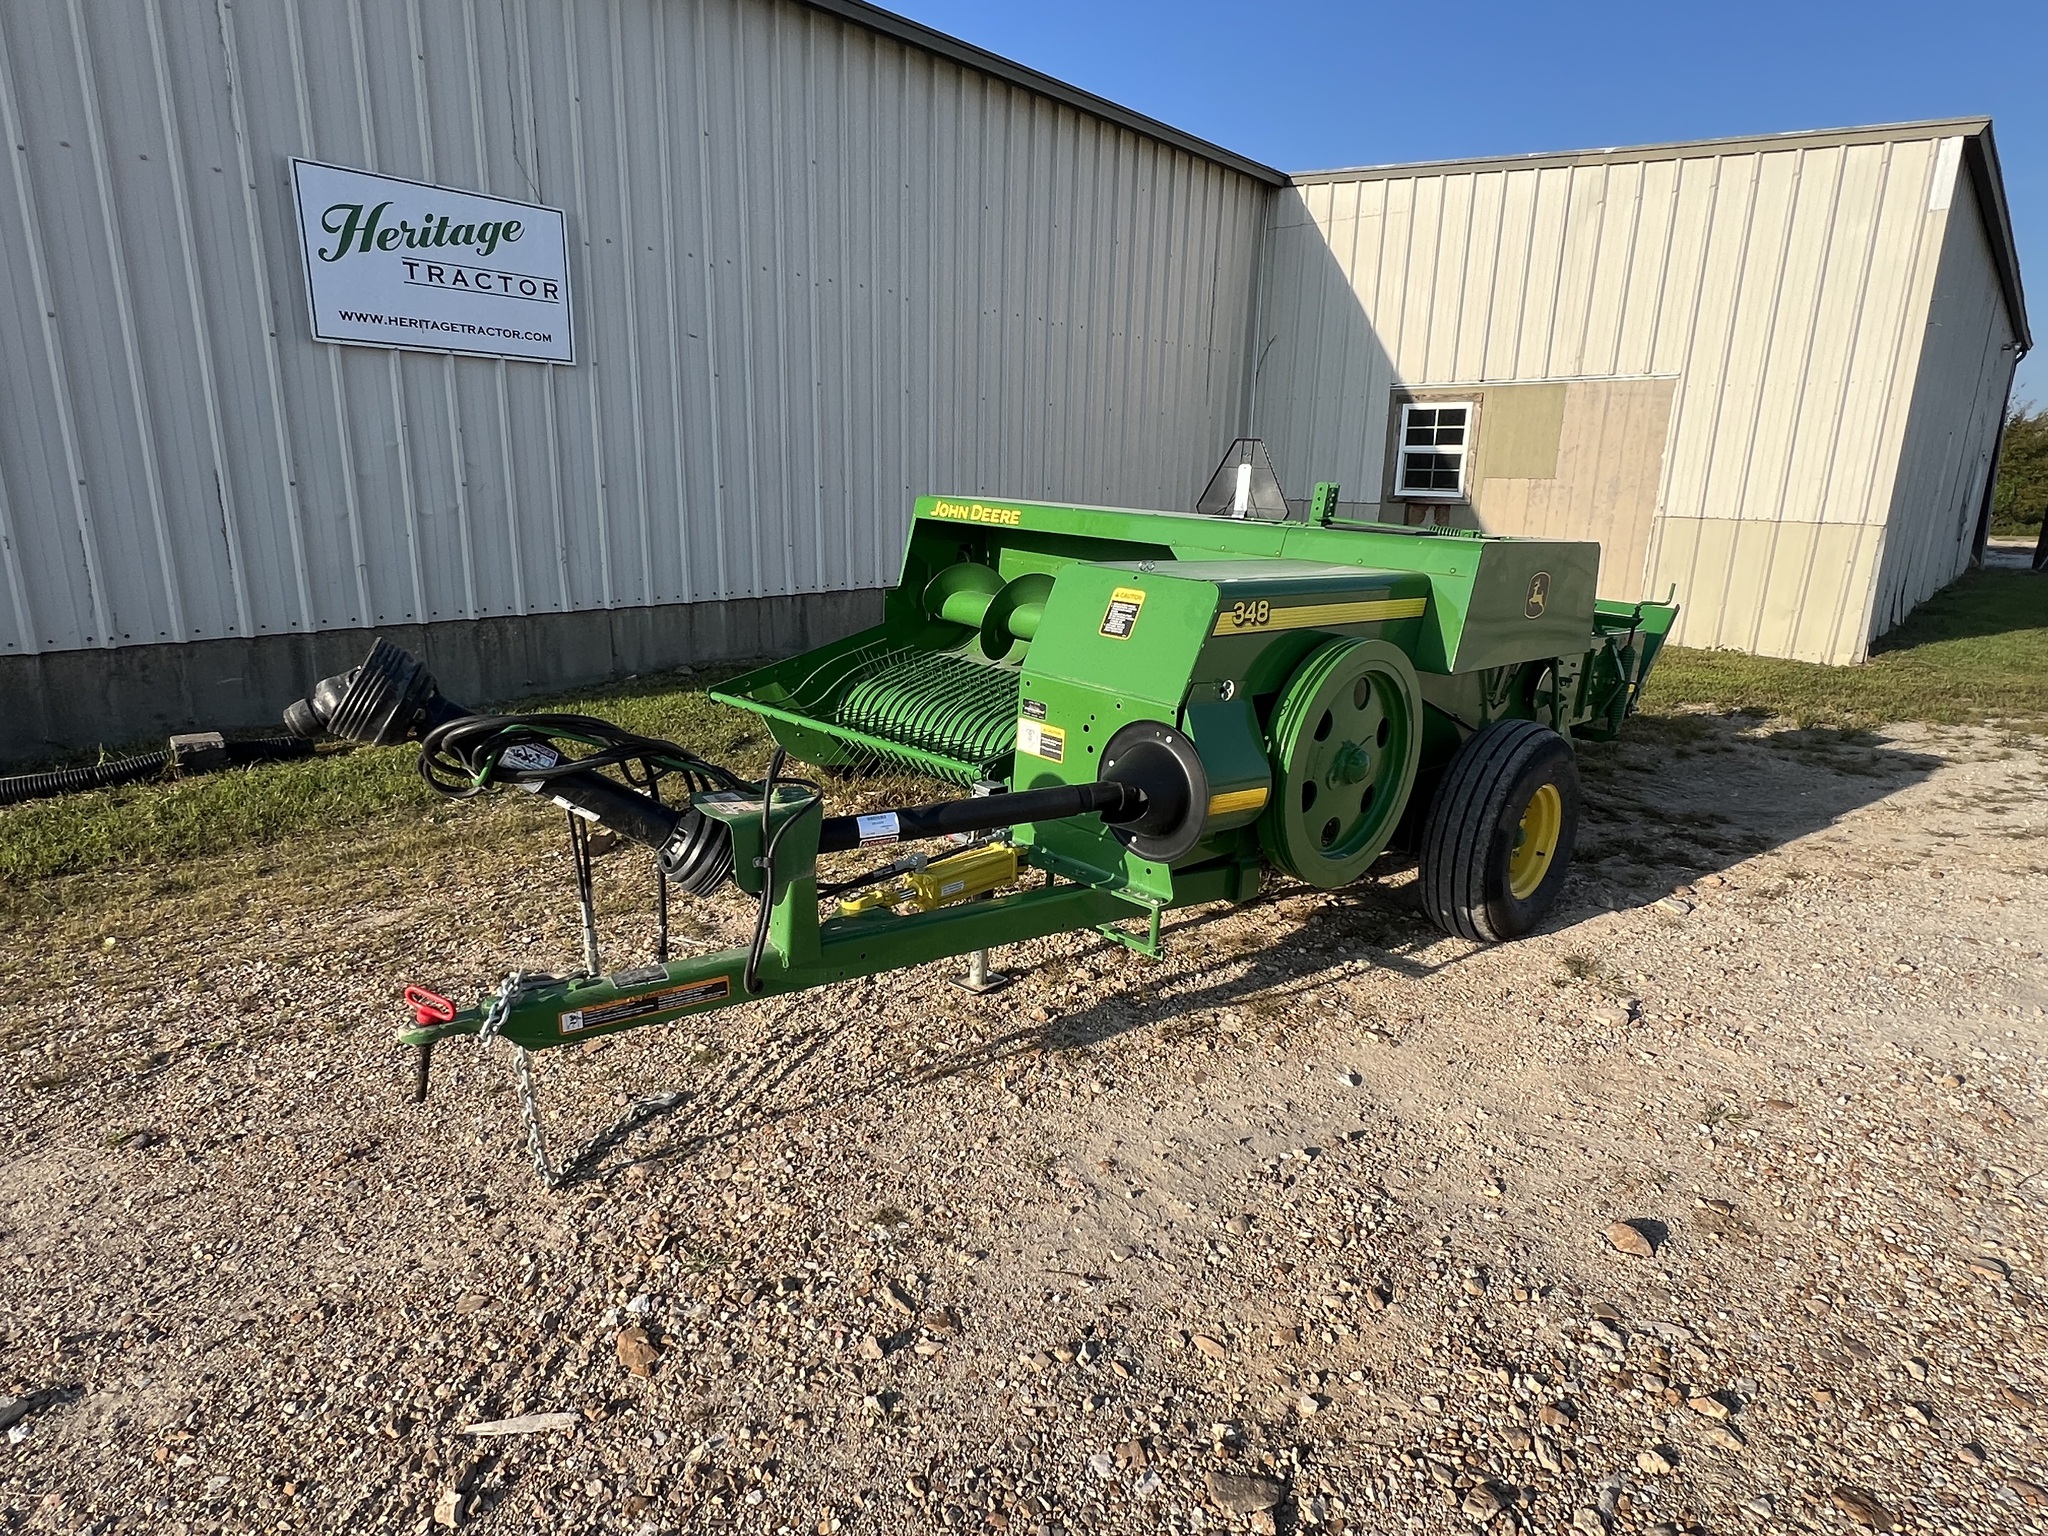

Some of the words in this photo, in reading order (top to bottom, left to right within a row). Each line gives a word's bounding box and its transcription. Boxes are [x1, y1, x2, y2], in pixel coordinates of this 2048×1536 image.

[318, 201, 525, 262] Heritage
[403, 262, 558, 299] TRACTOR
[338, 310, 552, 342] WWW.HERITAGETRACTOR.COM
[930, 500, 969, 520] JOHN
[970, 504, 1021, 525] DEERE
[1120, 592, 1143, 601] CAUTION
[1232, 600, 1270, 626] 348
